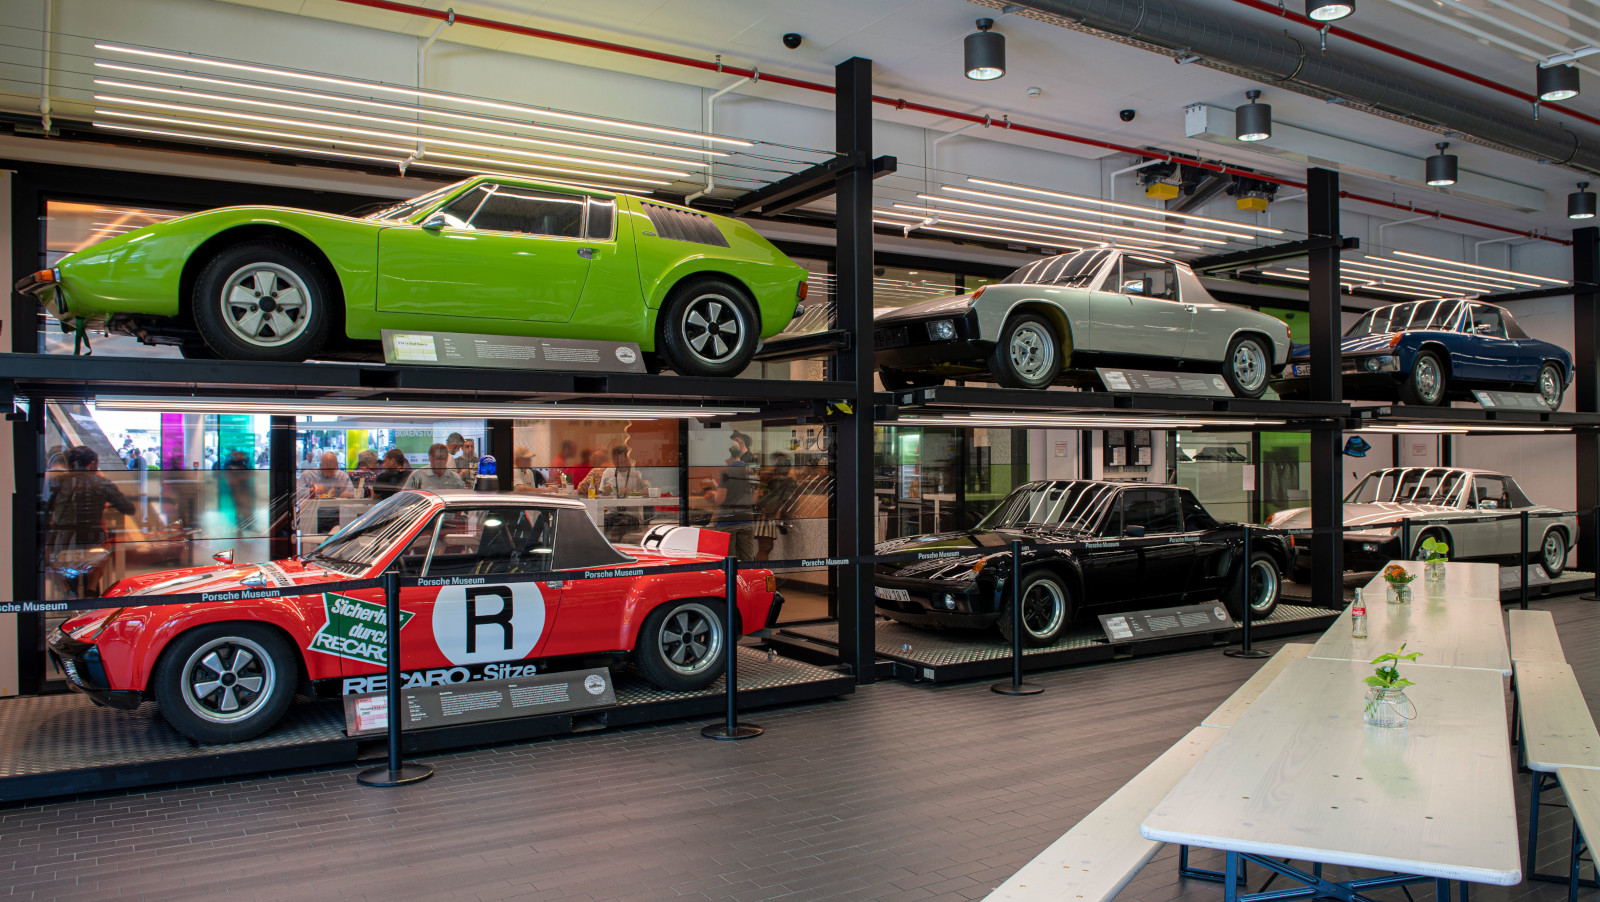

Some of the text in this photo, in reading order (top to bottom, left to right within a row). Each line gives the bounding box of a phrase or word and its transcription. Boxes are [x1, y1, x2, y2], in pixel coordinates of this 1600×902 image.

[918, 550, 960, 560] Porsche Museum
[801, 558, 849, 567] Porsche Museum
[585, 568, 644, 579] Porsche Museum
[418, 576, 485, 586] Porsche Museum
[202, 590, 280, 602] Porsche Museum
[22, 602, 68, 612] Museum
[465, 585, 513, 654] R
